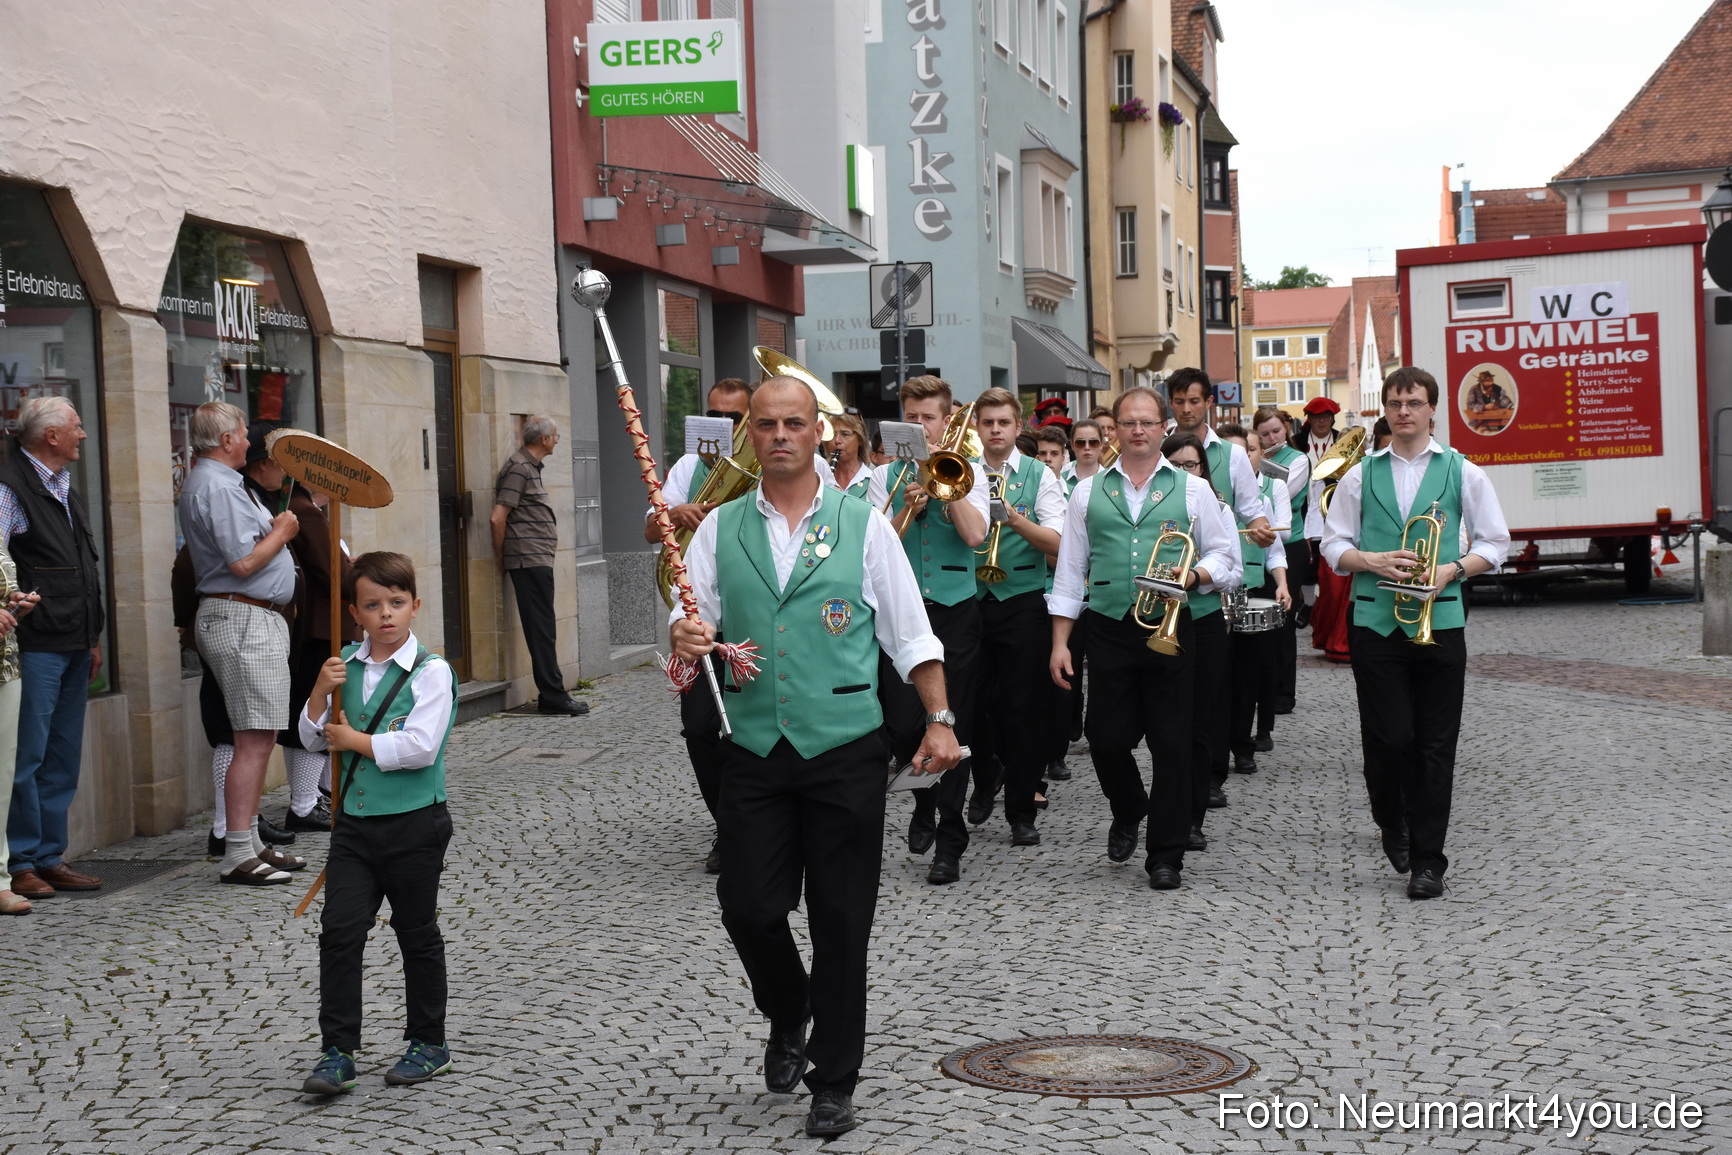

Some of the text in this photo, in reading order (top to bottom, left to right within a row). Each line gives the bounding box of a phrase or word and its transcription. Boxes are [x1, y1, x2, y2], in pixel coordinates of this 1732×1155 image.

[599, 37, 702, 67] GEERS
[601, 89, 704, 107] GUTES HÖREN
[7, 269, 85, 301] Erlebnishaus.
[201, 297, 214, 317] im
[214, 280, 259, 341] RACKL
[260, 306, 309, 330] Erlebnishaus.
[816, 319, 846, 332] IHR
[1456, 318, 1650, 354] RUMMEL
[1519, 348, 1650, 370] Getränke
[1577, 368, 1628, 378] Heimdienst
[1577, 376, 1643, 388] Party-Service
[1578, 386, 1634, 397] Abholmarkt
[1578, 397, 1604, 406] Weine
[1578, 405, 1634, 416] Gastronomie
[1579, 427, 1625, 435] verschiedenen
[1579, 435, 1613, 443] Biertische
[1628, 432, 1651, 440] Bänke
[284, 440, 373, 486] Jugendblaskapelle
[1467, 454, 1490, 463] 2369
[1493, 450, 1565, 462] Reichertshofen
[1576, 447, 1594, 458] Tel.
[1597, 444, 1653, 456] 09181/1034
[304, 467, 350, 502] Nabburg
